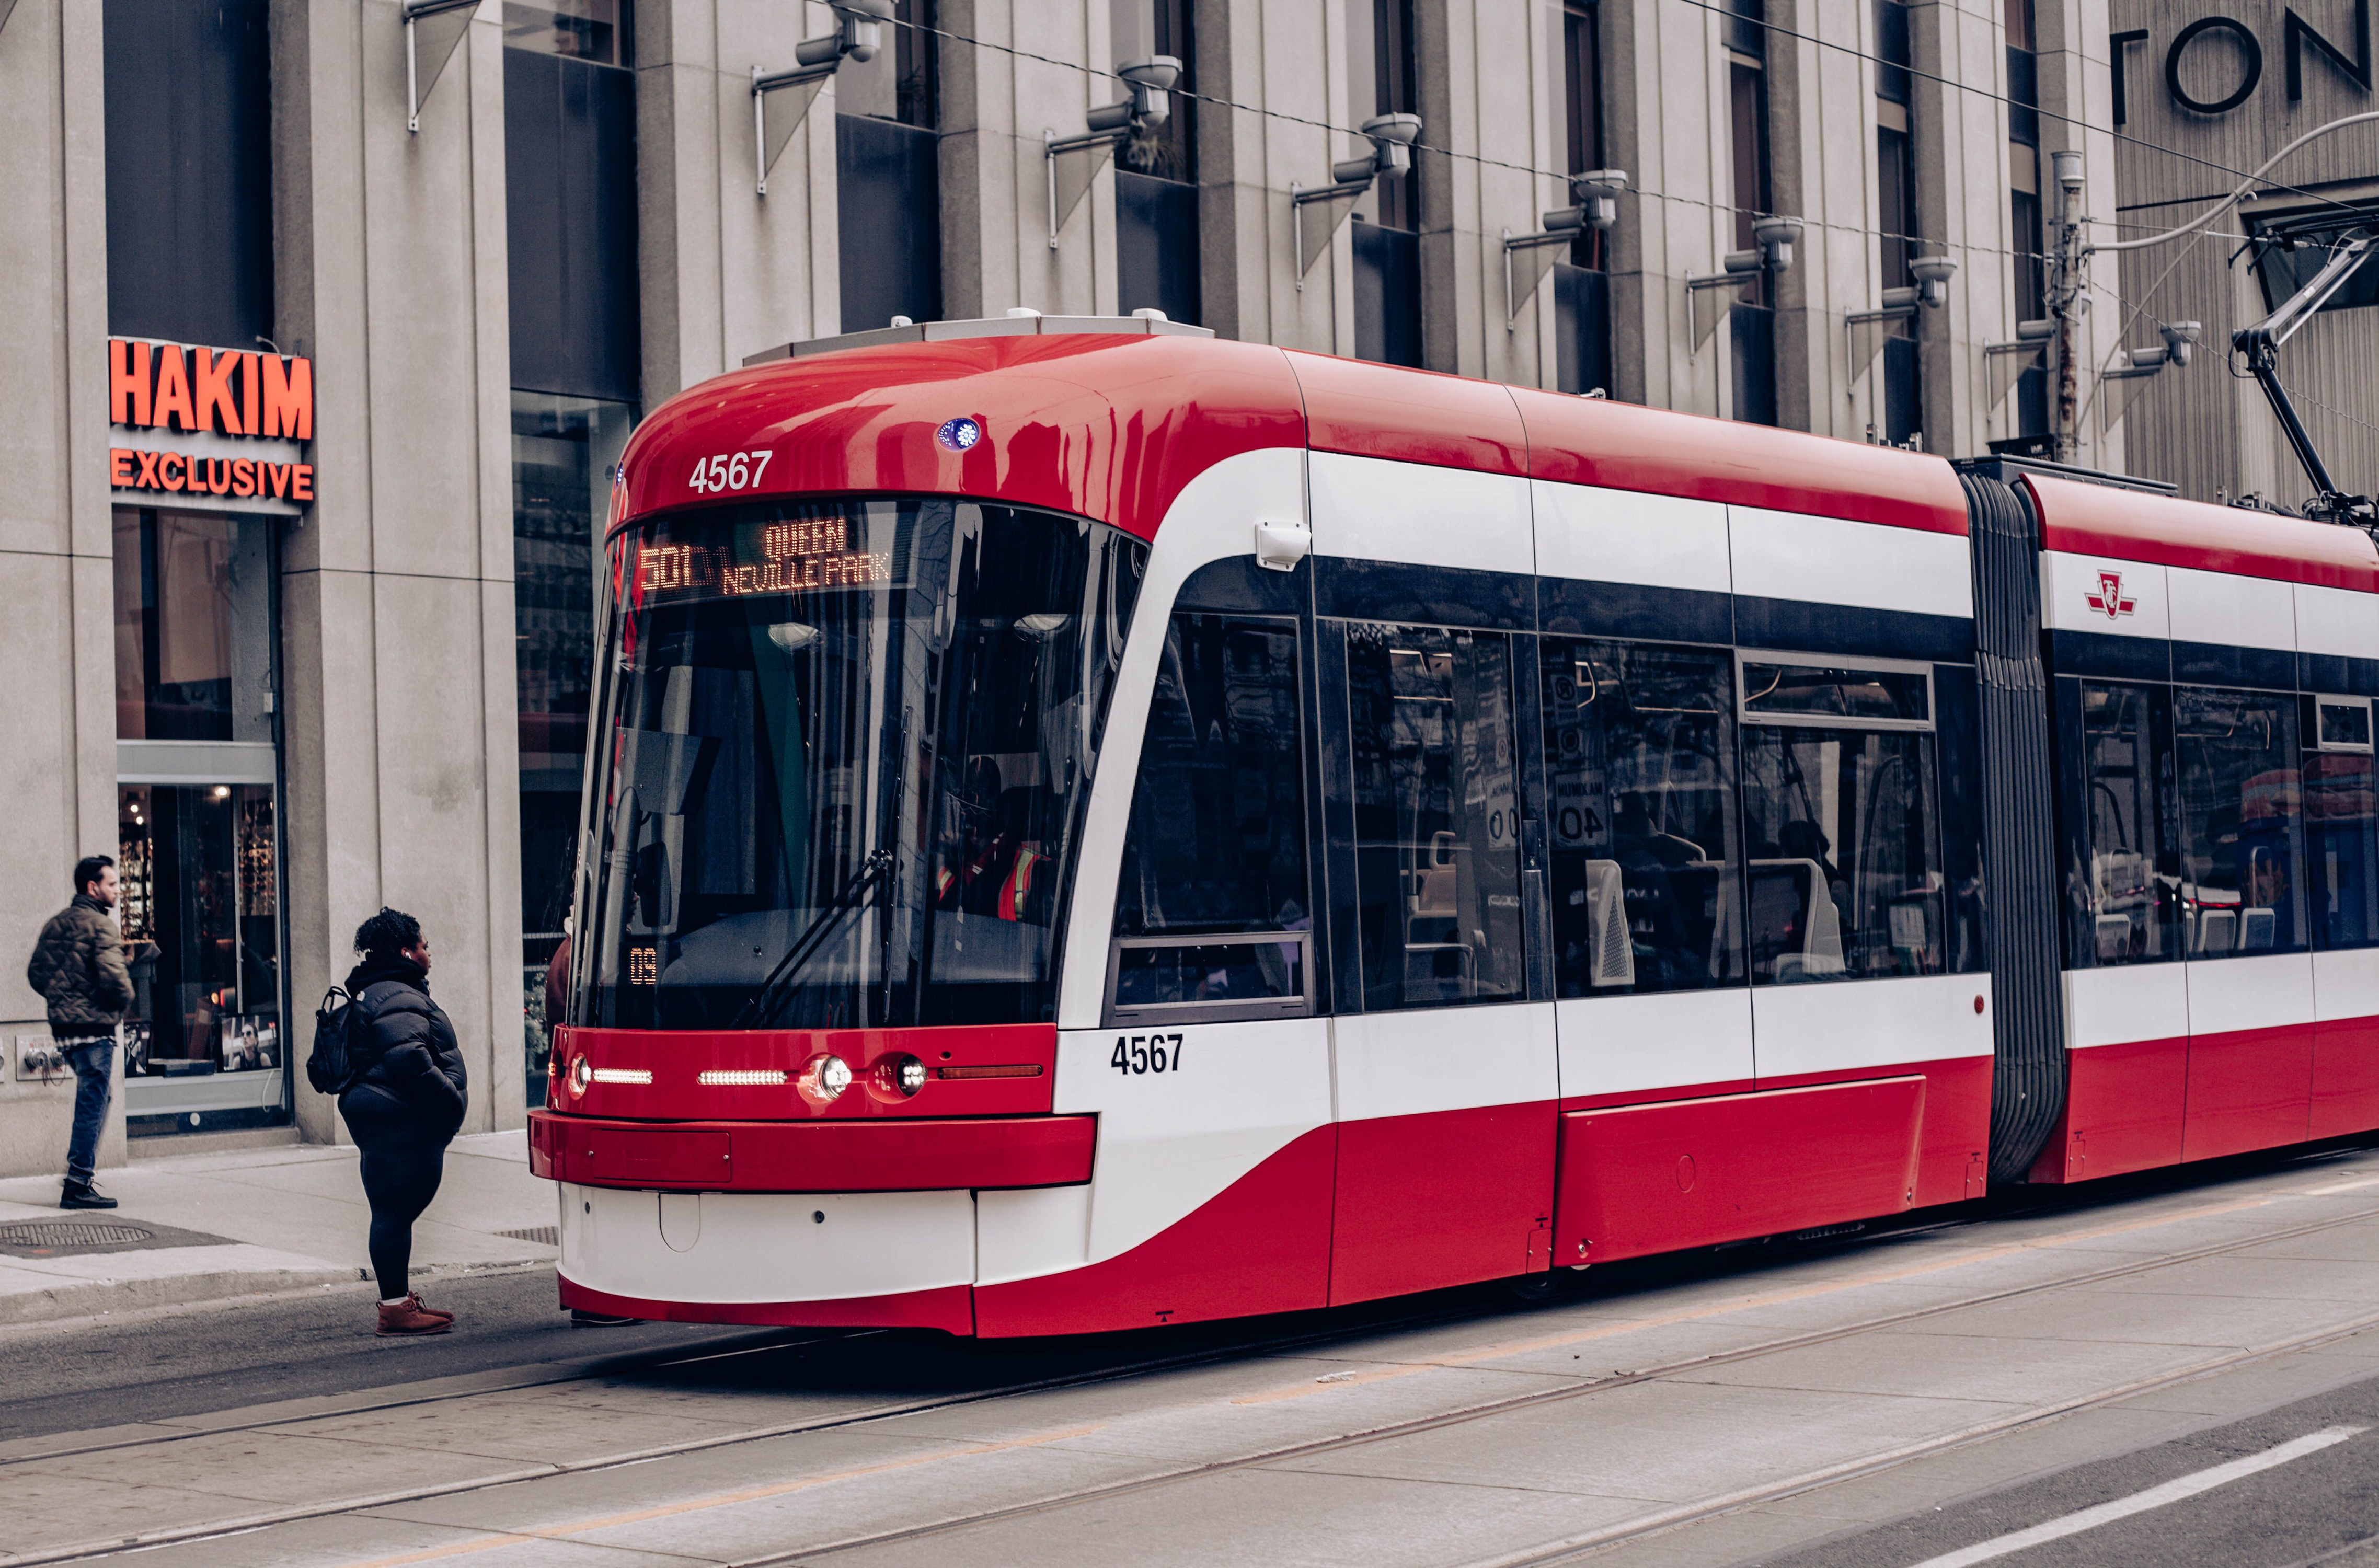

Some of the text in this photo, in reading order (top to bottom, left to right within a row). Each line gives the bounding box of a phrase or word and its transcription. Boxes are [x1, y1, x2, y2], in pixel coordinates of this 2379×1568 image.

[110, 340, 313, 440] HAKIM
[110, 448, 313, 501] EXCLUSIVE
[689, 449, 773, 494] 4567
[765, 518, 845, 561] QUEEN
[640, 545, 690, 590] 501
[723, 552, 889, 595] NEVILLE PARK
[630, 948, 656, 984] 09
[1111, 1033, 1183, 1075] 4567
